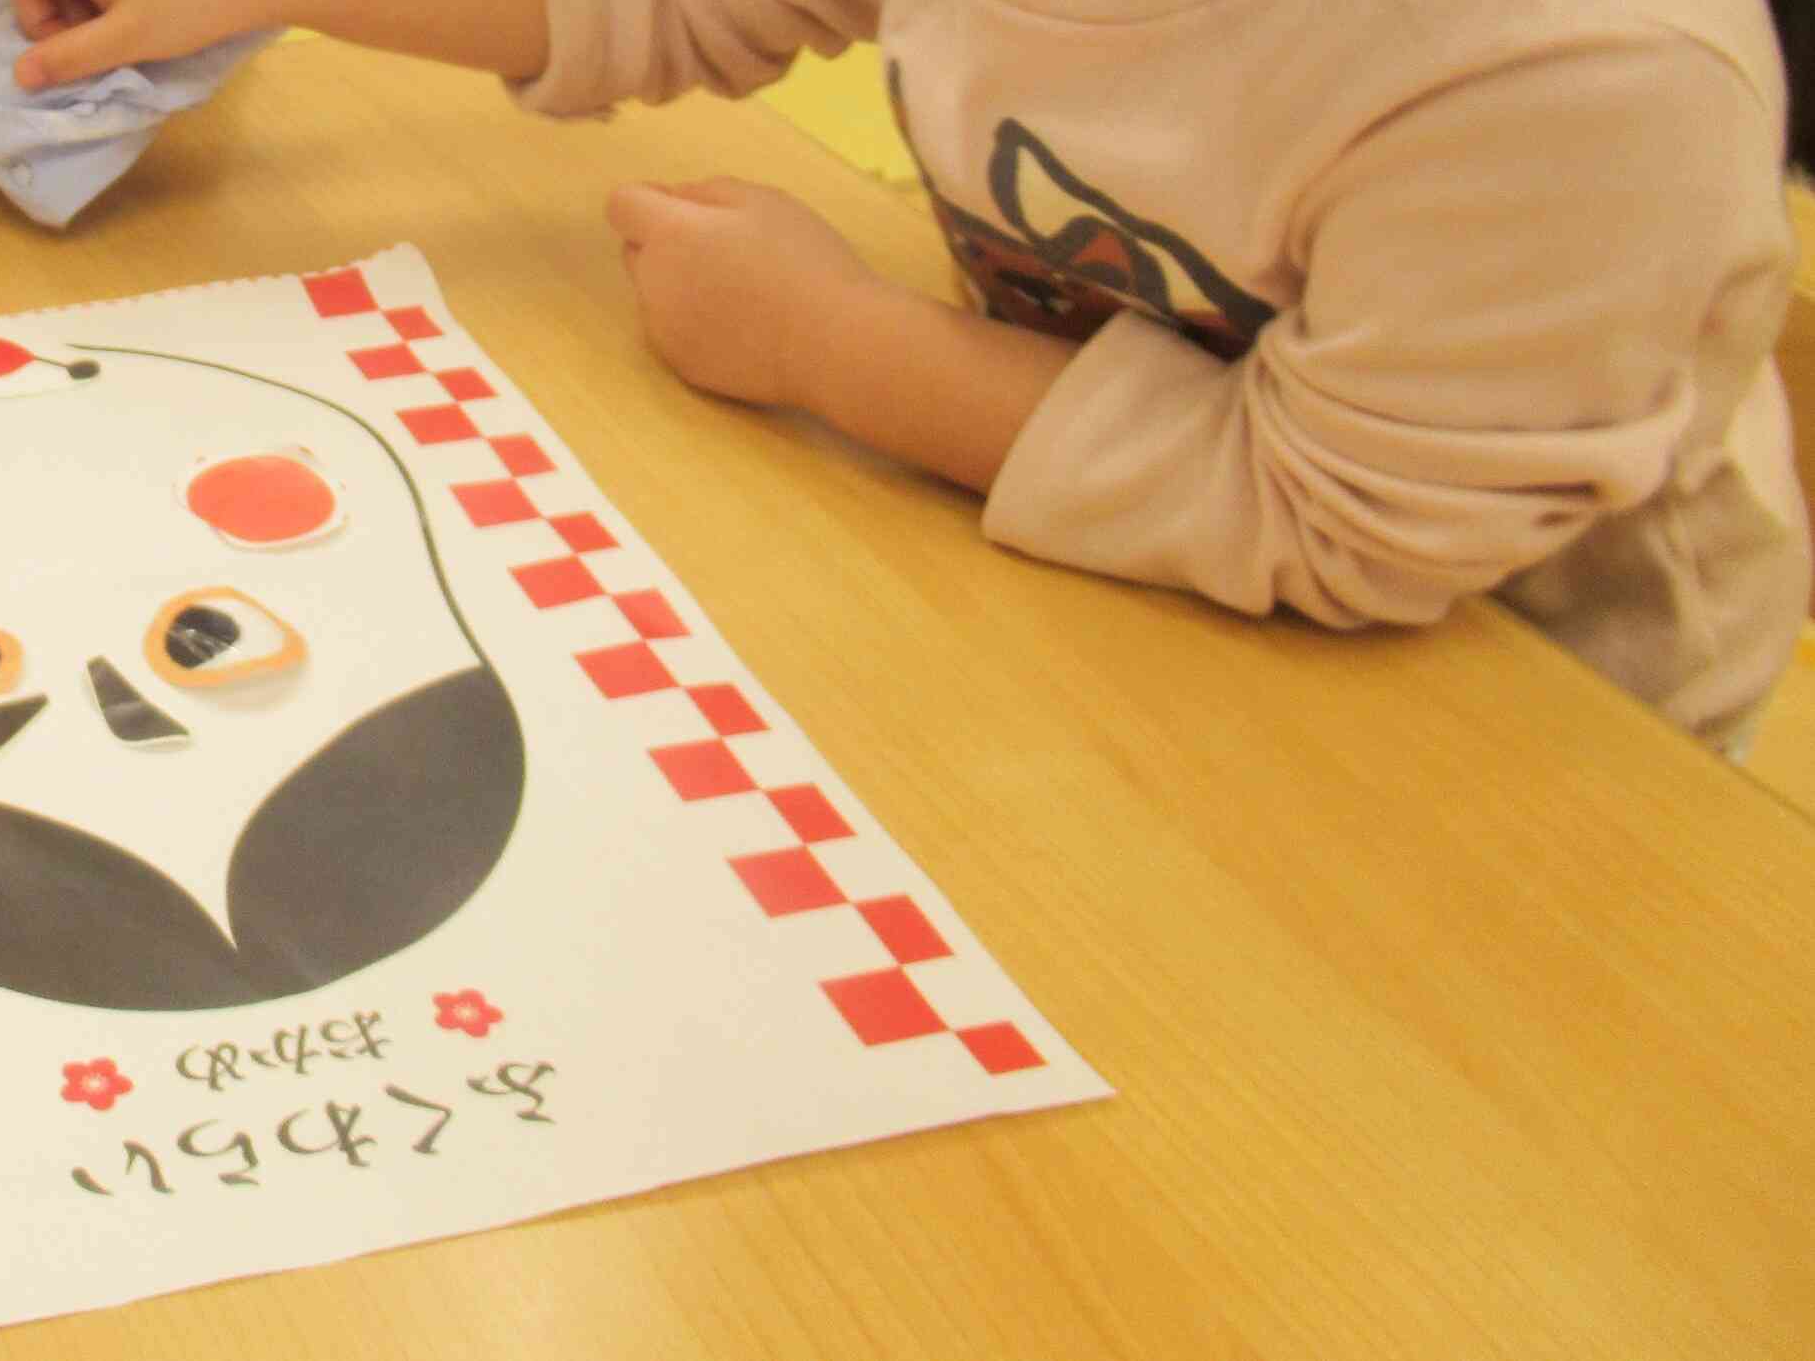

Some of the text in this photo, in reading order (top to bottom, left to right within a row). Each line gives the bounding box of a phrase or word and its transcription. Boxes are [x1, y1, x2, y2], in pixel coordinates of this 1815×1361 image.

[177, 1012, 391, 1091] おかめ
[71, 1061, 555, 1196] ふくわらい
